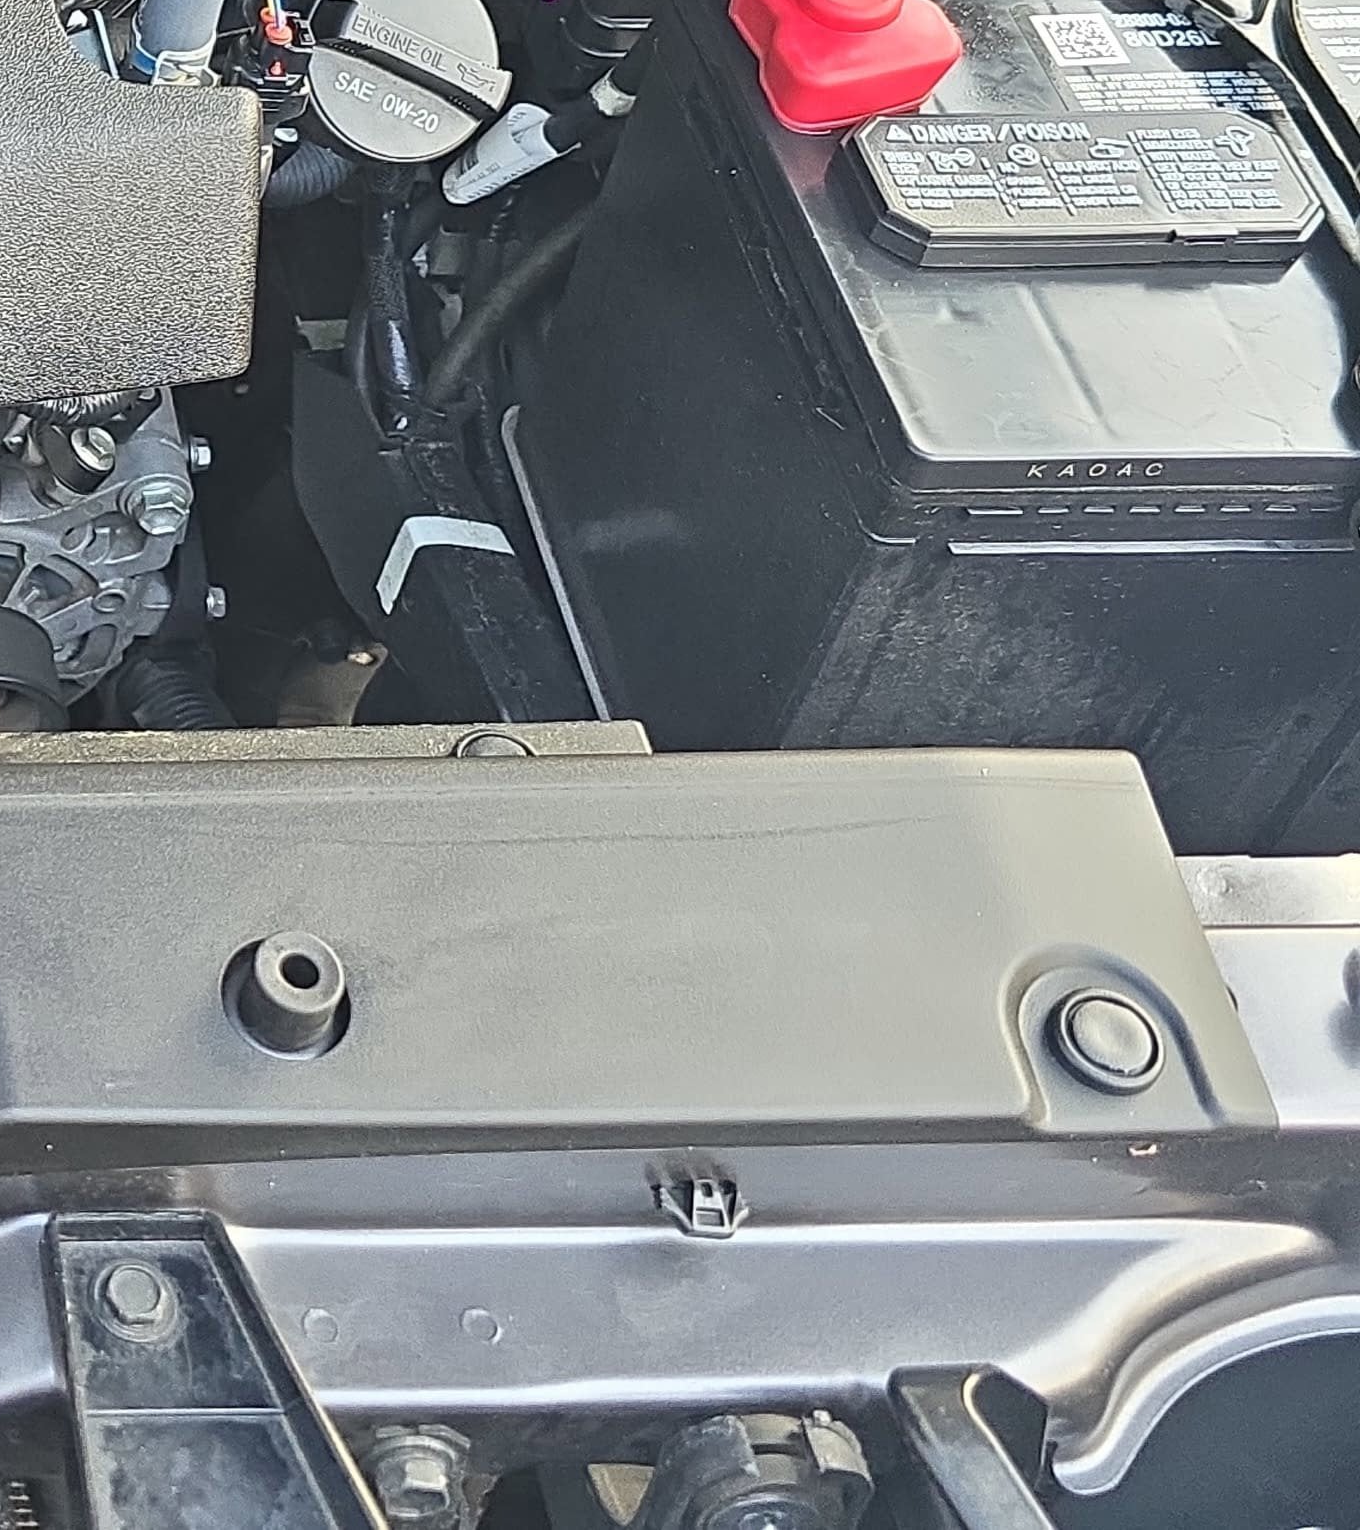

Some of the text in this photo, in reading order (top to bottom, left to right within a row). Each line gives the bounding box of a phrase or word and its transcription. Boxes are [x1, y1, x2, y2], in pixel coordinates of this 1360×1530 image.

[351, 14, 448, 72] ENGINE OIL
[1122, 30, 1222, 47] 80D26L
[334, 72, 440, 133] SAE 0W-20
[1026, 462, 1165, 479] KAOAC
